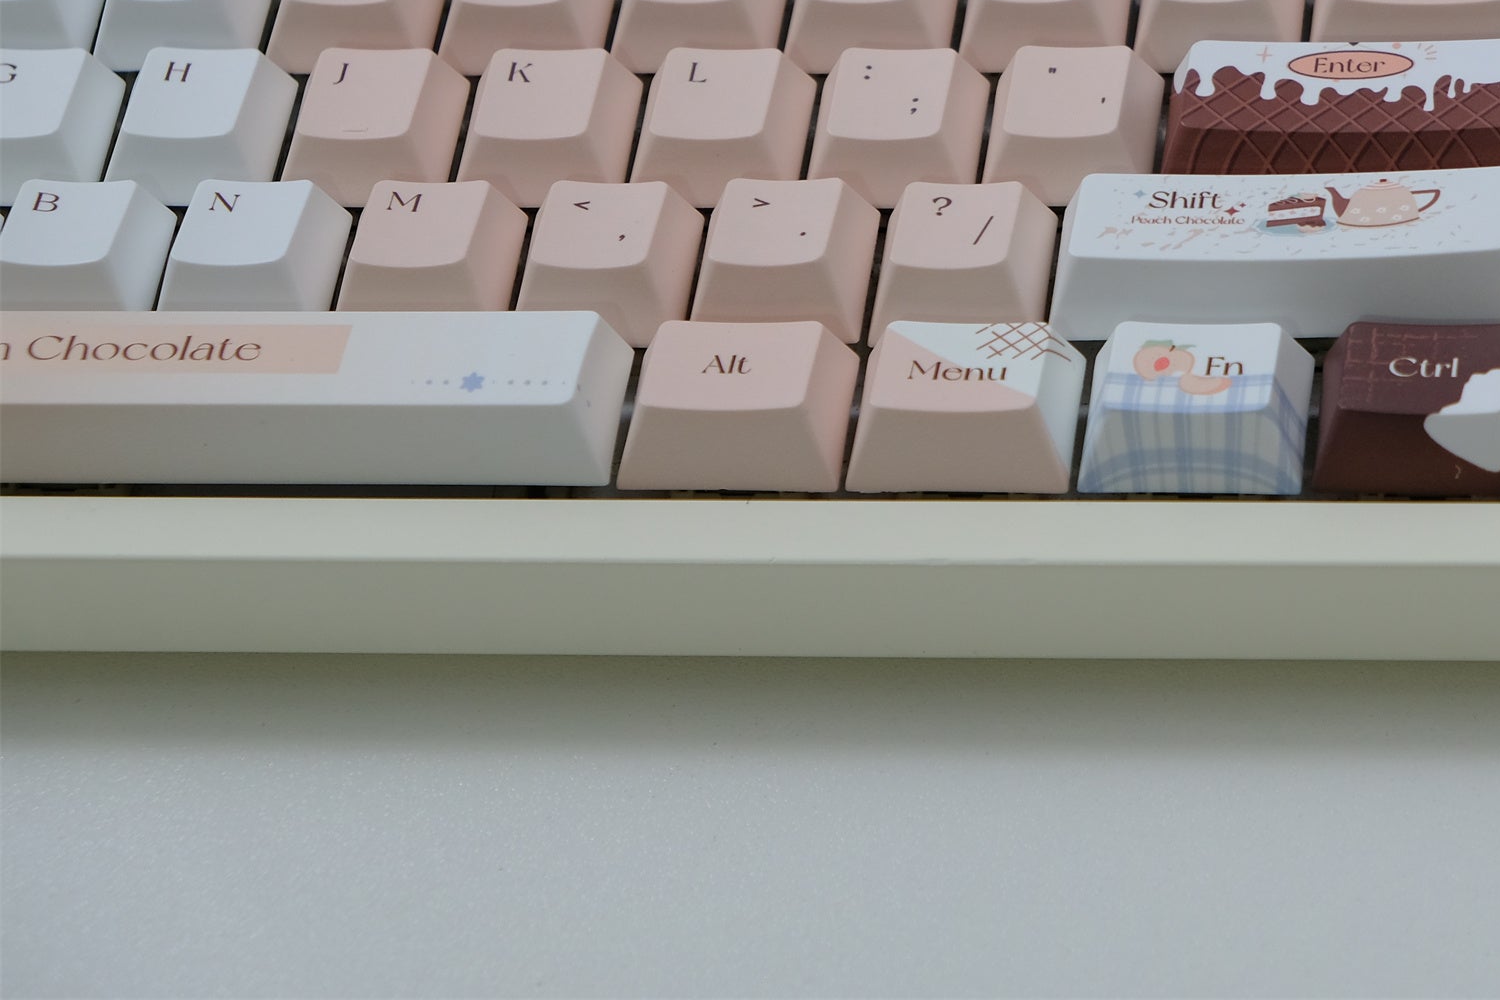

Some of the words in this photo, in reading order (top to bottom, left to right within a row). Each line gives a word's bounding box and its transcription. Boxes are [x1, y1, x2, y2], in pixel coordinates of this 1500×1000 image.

[164, 61, 192, 83] H
[333, 62, 350, 85] J
[507, 61, 533, 83] K
[688, 61, 707, 83] L
[863, 64, 873, 80] :
[1312, 55, 1388, 75] Enter
[910, 97, 919, 115] ;
[32, 191, 60, 213] B
[208, 191, 241, 213] N
[386, 191, 423, 213] M
[573, 200, 591, 211] <
[752, 197, 771, 208] >
[932, 196, 953, 217] ?
[1148, 190, 1221, 210] Shift
[972, 215, 994, 246] /
[1130, 215, 1172, 225] Peach
[1174, 214, 1246, 226] Chocolate
[26, 335, 262, 361] Chocolate
[701, 353, 751, 375] Alt
[906, 359, 1008, 382] Menu
[1205, 356, 1244, 376] Fn
[1388, 357, 1459, 378] Ctrl
